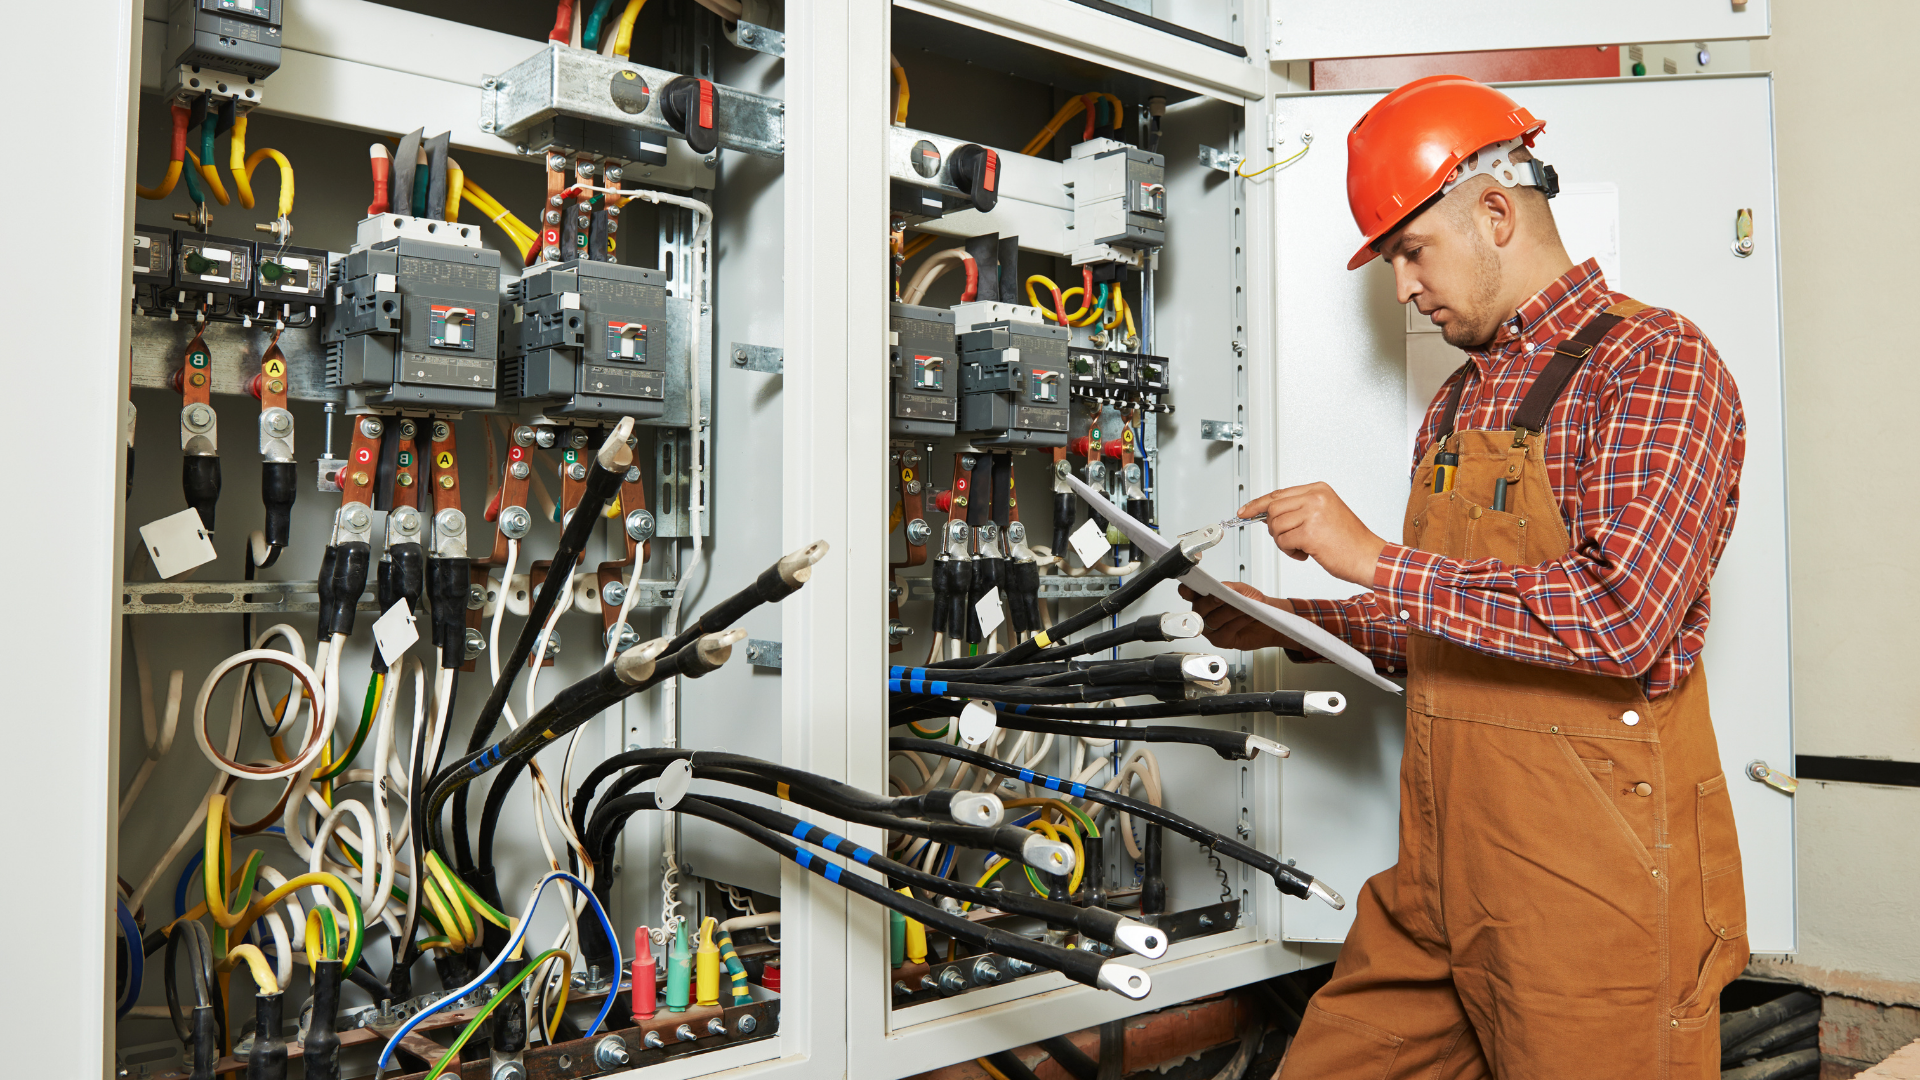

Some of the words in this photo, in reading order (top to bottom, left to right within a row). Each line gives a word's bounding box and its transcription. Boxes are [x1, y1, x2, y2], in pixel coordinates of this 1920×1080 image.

[270, 362, 281, 374] A
[1125, 431, 1131, 440] A
[440, 455, 451, 465] A
[904, 471, 912, 480] A
